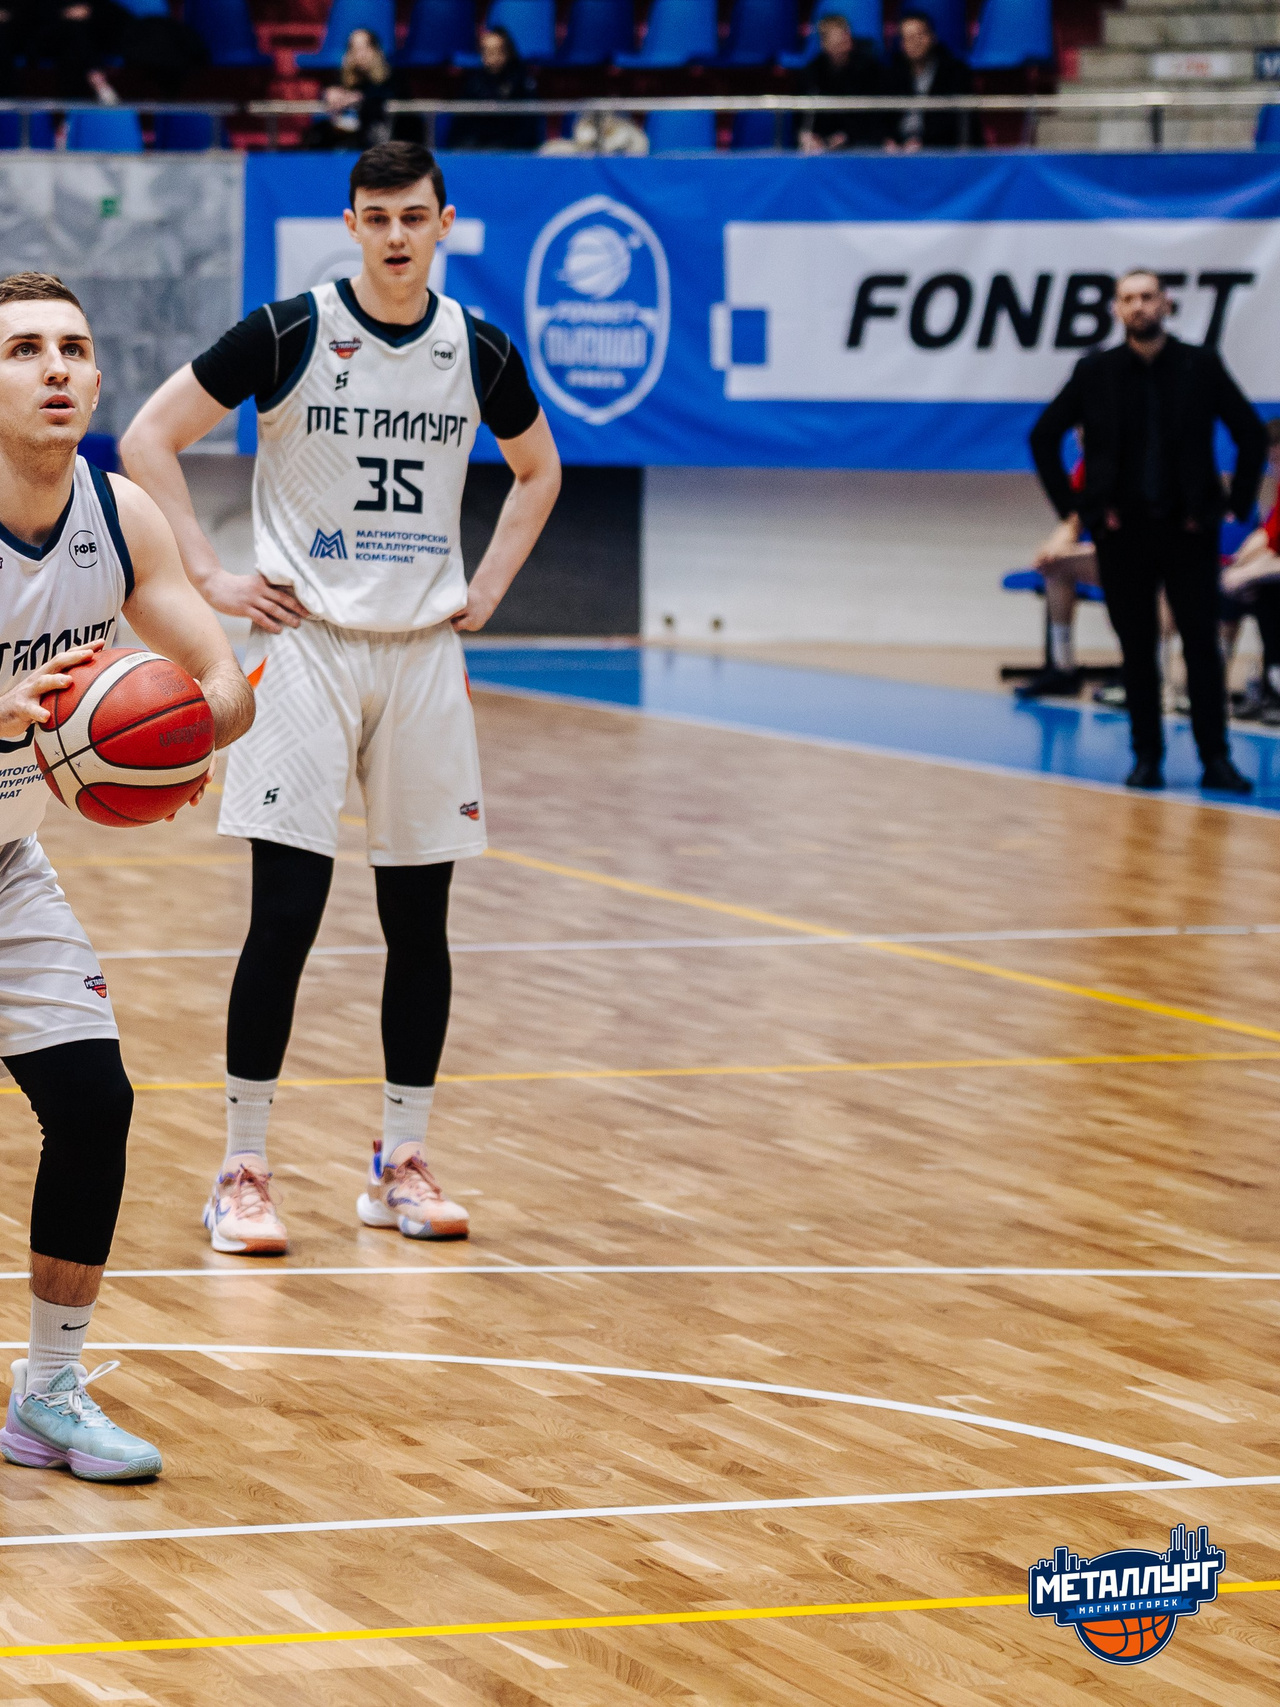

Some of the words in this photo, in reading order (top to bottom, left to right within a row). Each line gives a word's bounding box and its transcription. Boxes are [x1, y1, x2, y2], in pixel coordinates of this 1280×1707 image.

[307, 405, 469, 448] МЕТАЛЛУРГ
[353, 456, 425, 514] 35
[356, 530, 448, 545] МАГНИТОГОРСКИЙ
[73, 541, 98, 556] РФБ
[355, 552, 416, 564] КОМБИНАТ
